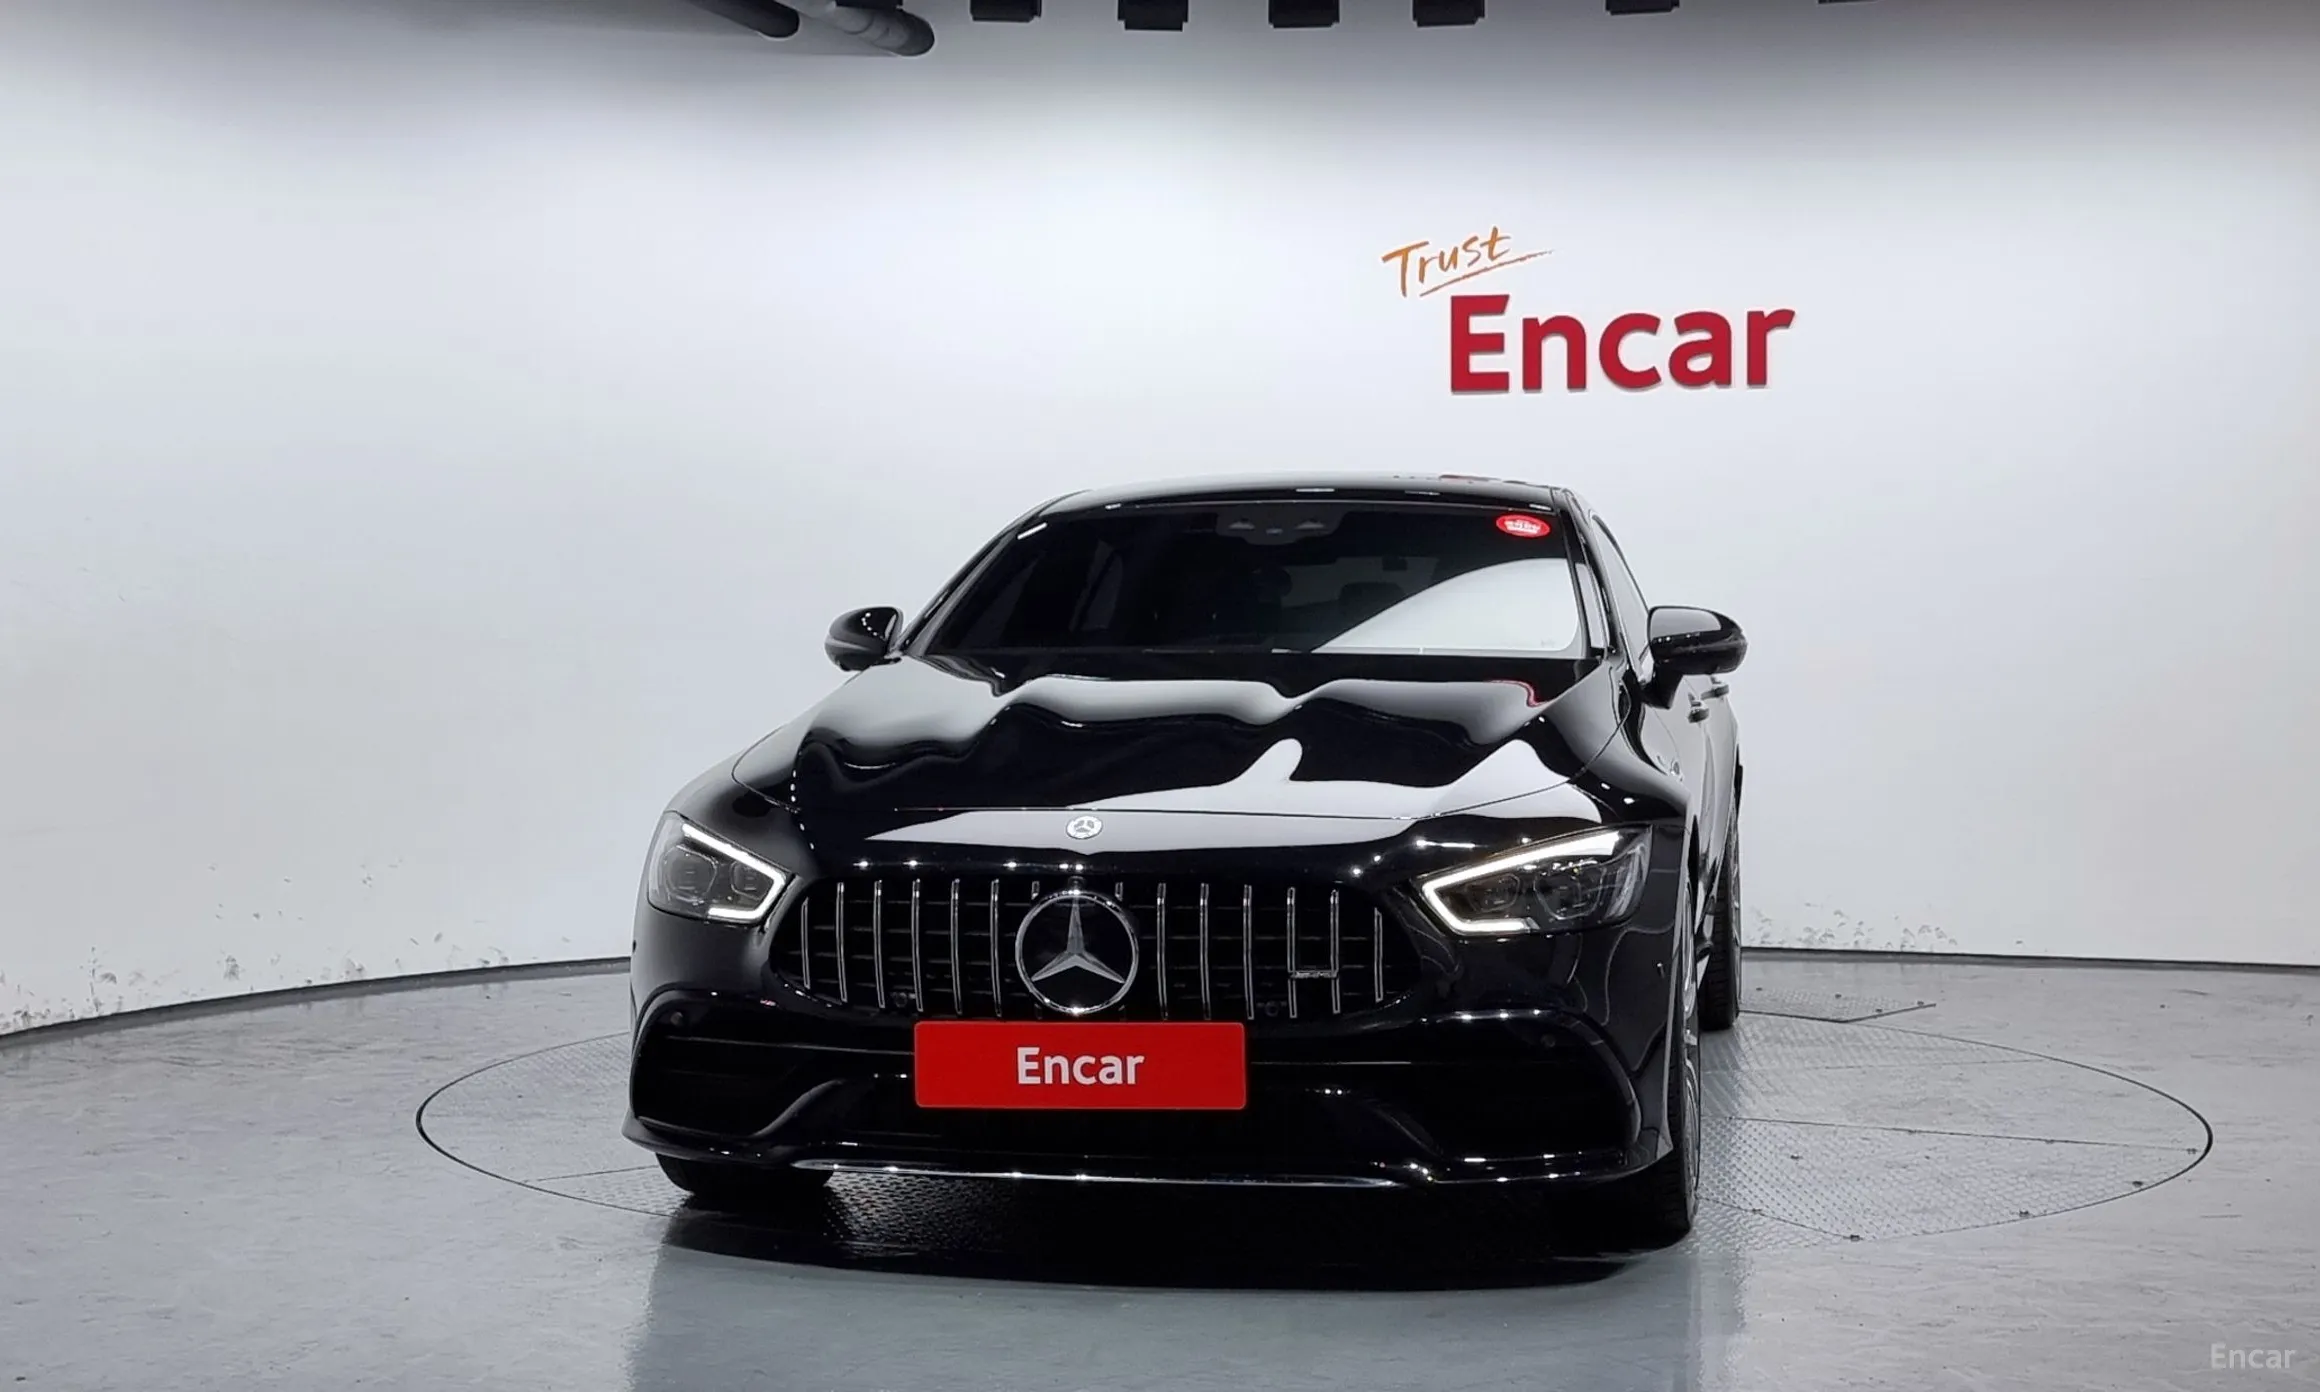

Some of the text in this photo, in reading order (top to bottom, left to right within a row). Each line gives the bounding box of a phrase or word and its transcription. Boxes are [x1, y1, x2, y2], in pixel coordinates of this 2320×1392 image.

[1382, 226, 1511, 297] Trust
[1451, 294, 1795, 392] Encar
[1017, 1047, 1144, 1085] Encar
